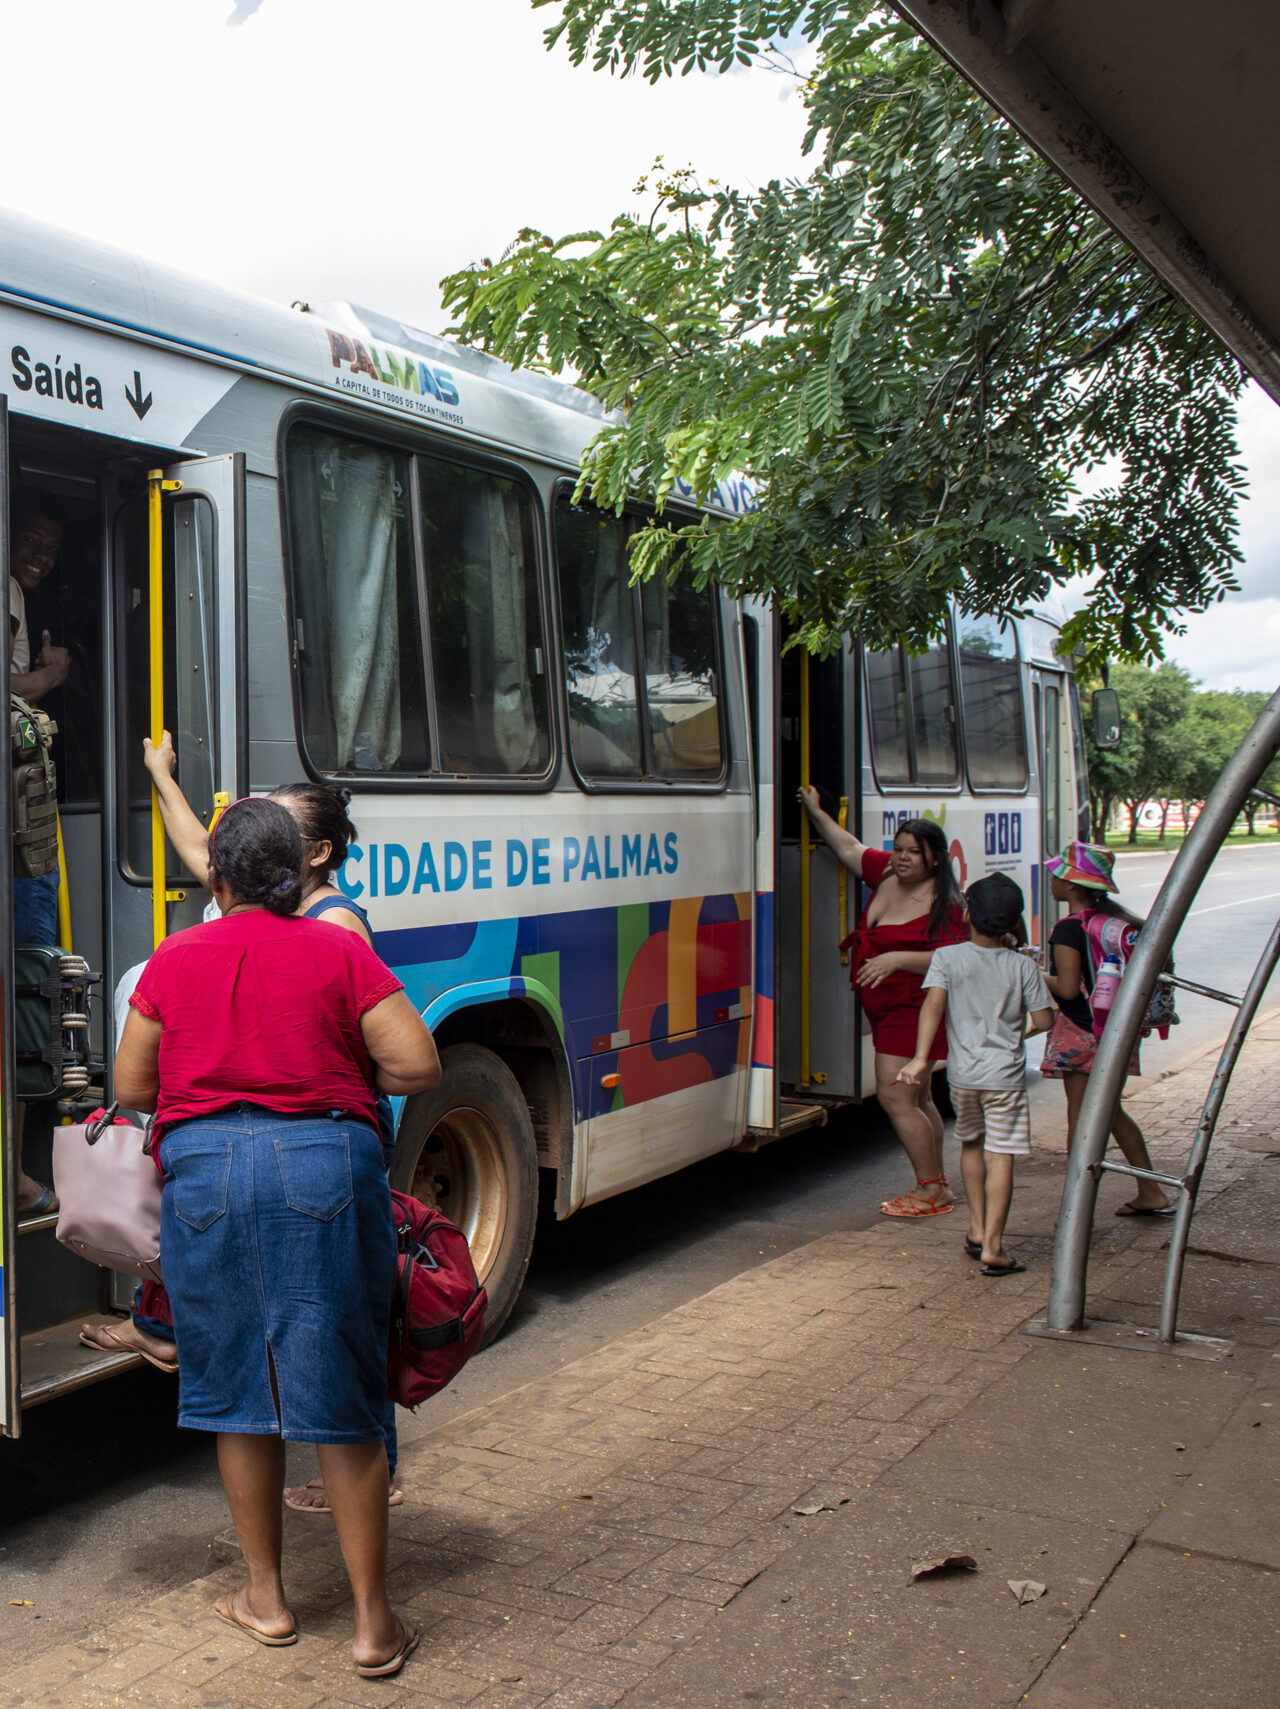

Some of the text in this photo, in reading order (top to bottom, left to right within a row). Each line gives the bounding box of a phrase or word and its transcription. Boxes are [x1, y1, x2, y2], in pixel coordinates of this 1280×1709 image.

[11, 345, 103, 410] Saída
[325, 328, 460, 407] PALMAS
[335, 376, 464, 425] A CAPITAL DE TODOS OS TOCANTINENSES
[336, 831, 678, 900] CIDADE DE PALMAS
